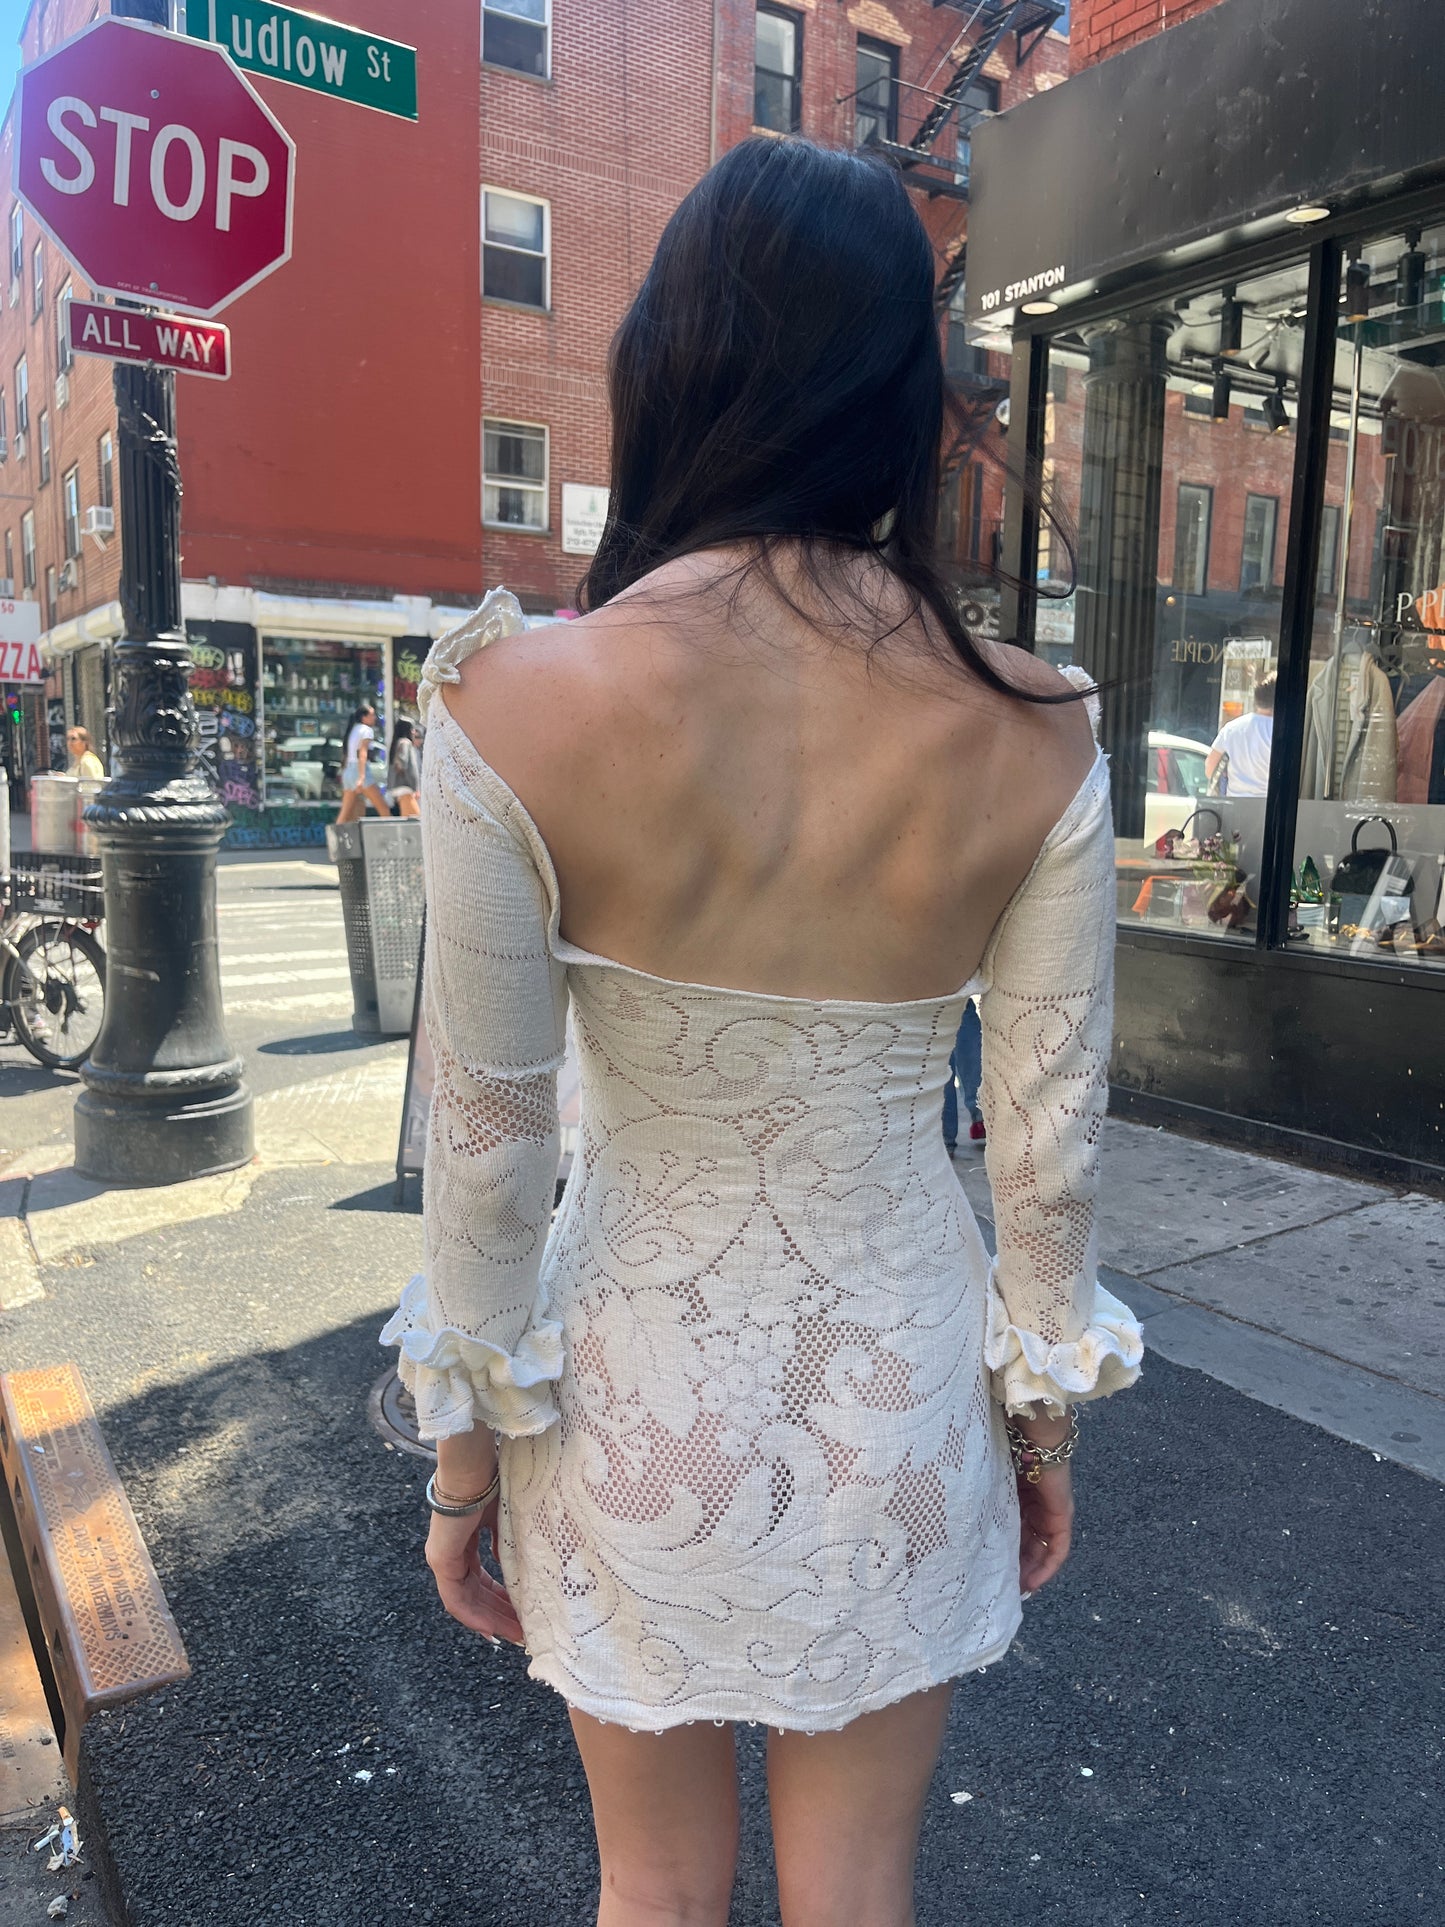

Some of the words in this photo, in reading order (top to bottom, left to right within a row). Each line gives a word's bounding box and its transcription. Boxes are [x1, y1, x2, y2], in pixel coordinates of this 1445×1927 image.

[208, 0, 347, 86] Ludlow
[367, 45, 391, 82] St
[40, 96, 270, 232] STOP
[981, 289, 1000, 310] 101
[1004, 265, 1065, 302] STANTON
[82, 313, 141, 350] ALL
[156, 325, 216, 364] WAY
[87, 1574, 123, 1641] WATERWAYS
[112, 1580, 138, 1617] WASTE
